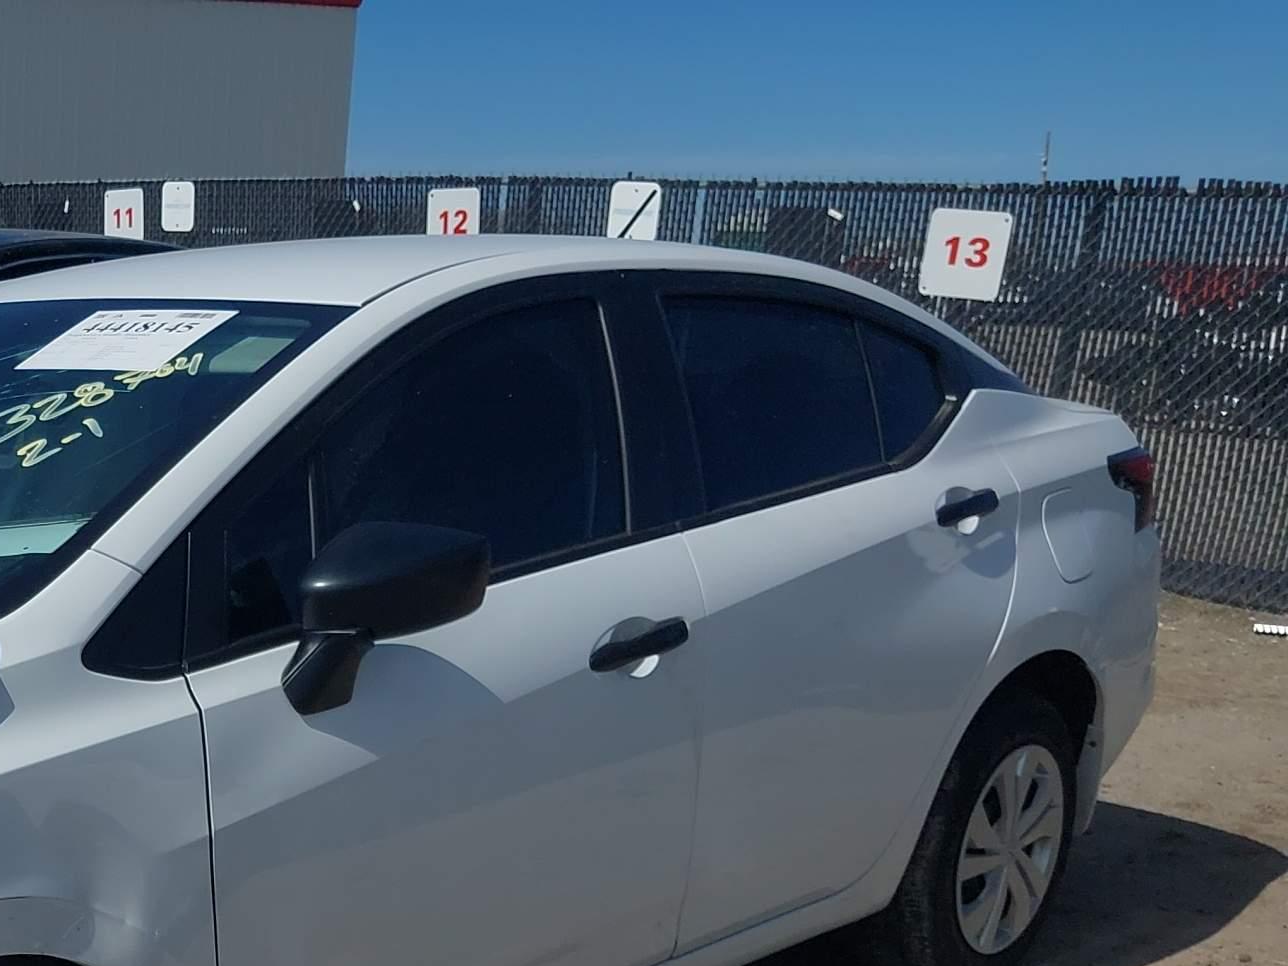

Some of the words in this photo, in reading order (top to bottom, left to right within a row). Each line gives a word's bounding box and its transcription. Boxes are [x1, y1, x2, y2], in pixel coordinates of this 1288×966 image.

[113, 207, 133, 229] 11
[439, 210, 469, 235] 12
[944, 236, 991, 268] 13
[82, 321, 201, 334] 44418145
